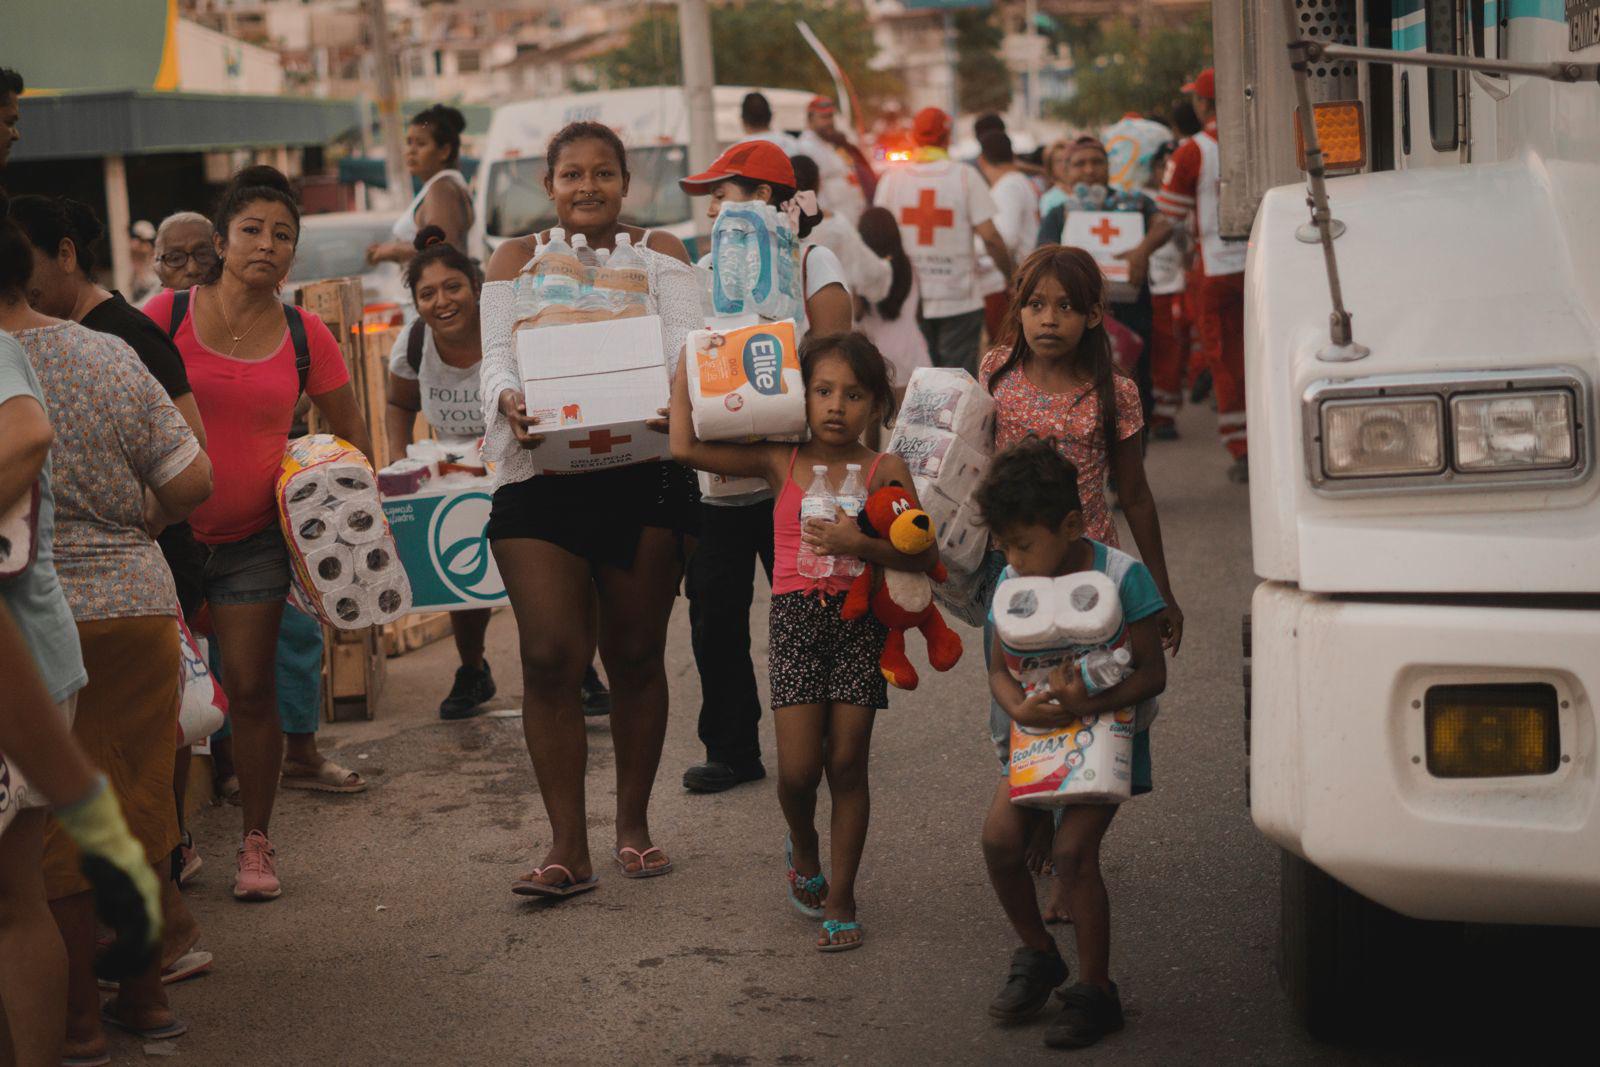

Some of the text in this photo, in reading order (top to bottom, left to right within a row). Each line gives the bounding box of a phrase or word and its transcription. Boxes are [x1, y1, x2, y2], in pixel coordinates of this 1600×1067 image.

[750, 340, 777, 390] Elite
[894, 435, 937, 456] Delsey
[571, 457, 633, 468] MEXICANA
[604, 453, 633, 461] ROJA
[1013, 733, 1069, 764] EcoMAX
